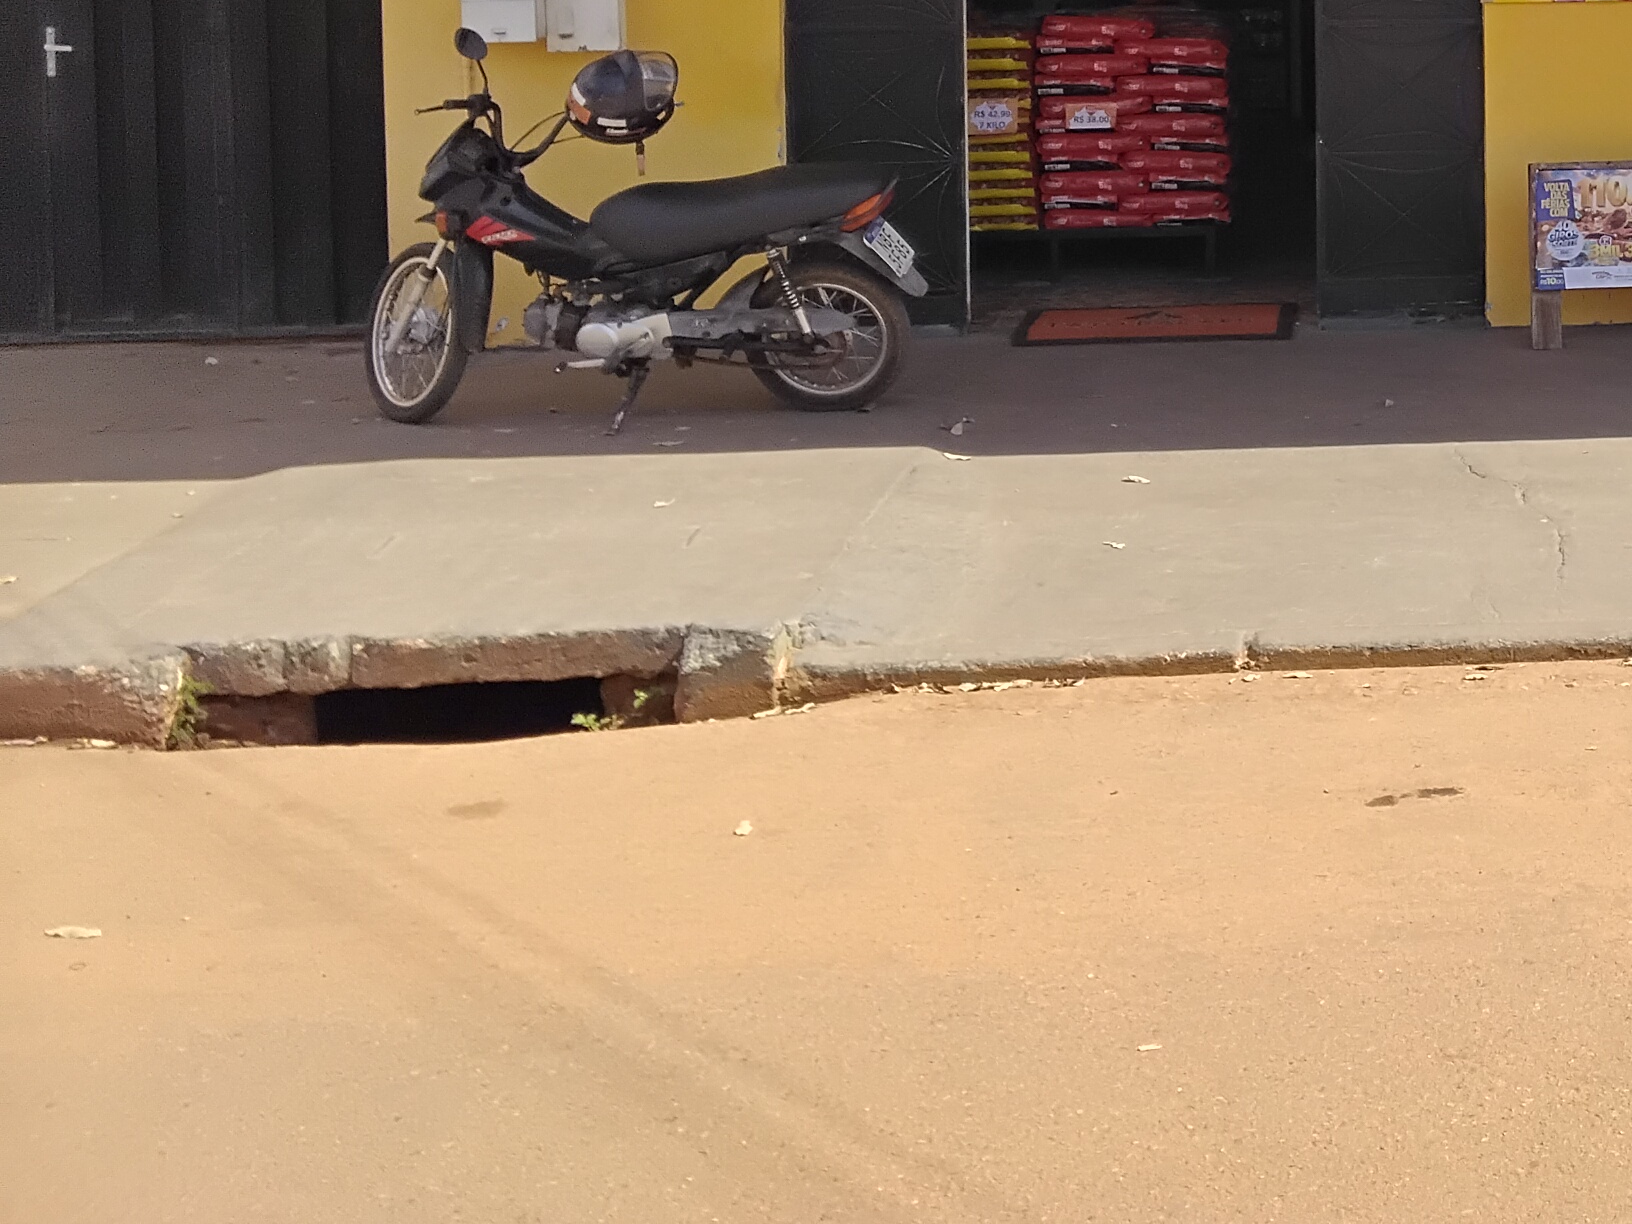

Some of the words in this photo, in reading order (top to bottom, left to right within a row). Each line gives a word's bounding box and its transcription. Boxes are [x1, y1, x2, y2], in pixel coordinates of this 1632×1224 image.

[974, 110, 985, 118] R$
[1073, 115, 1084, 124] R$
[1543, 182, 1570, 192] VOLTA
[1550, 191, 1567, 199] DAS
[1550, 208, 1568, 217] COM
